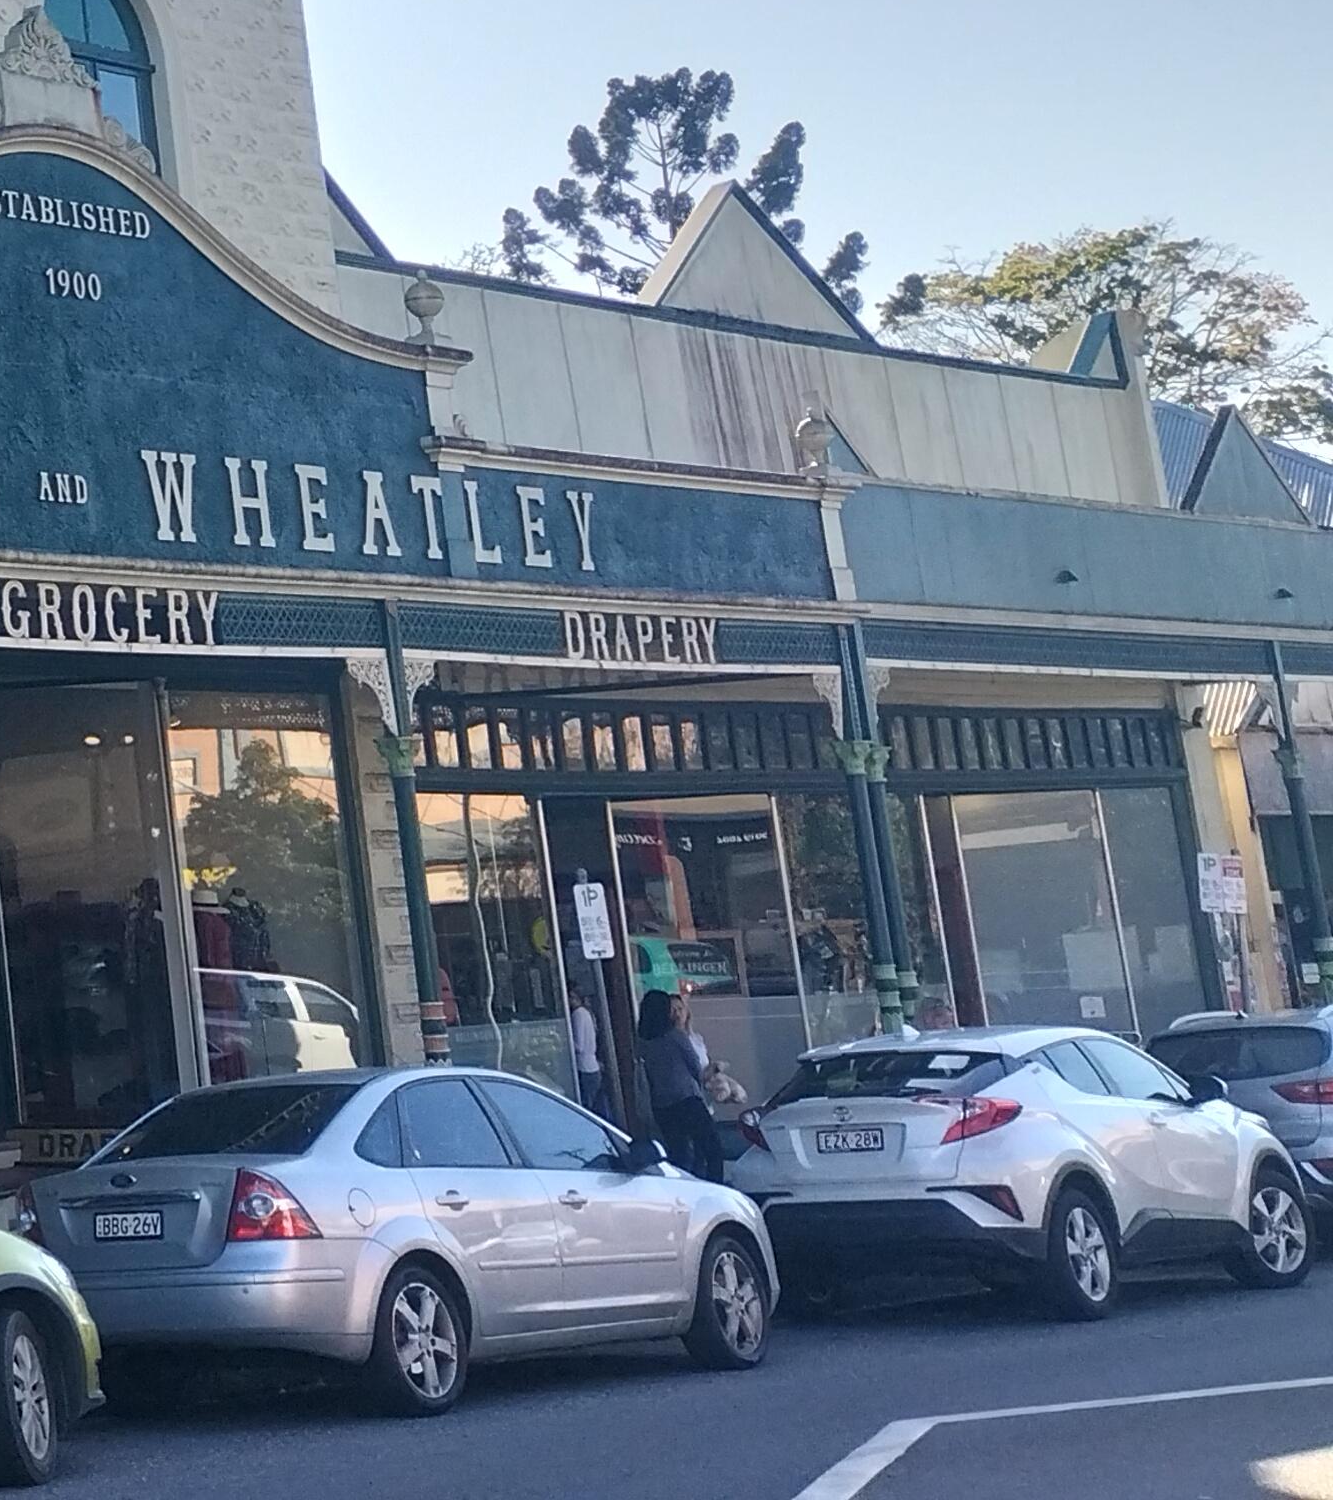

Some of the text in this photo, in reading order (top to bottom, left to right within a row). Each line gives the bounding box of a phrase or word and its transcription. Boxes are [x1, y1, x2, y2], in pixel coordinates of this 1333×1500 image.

[45, 267, 102, 302] 1900
[39, 471, 88, 505] AND
[141, 450, 596, 572] WHEATLEY
[2, 580, 220, 646] GROCERY
[563, 611, 718, 664] DRAPERY
